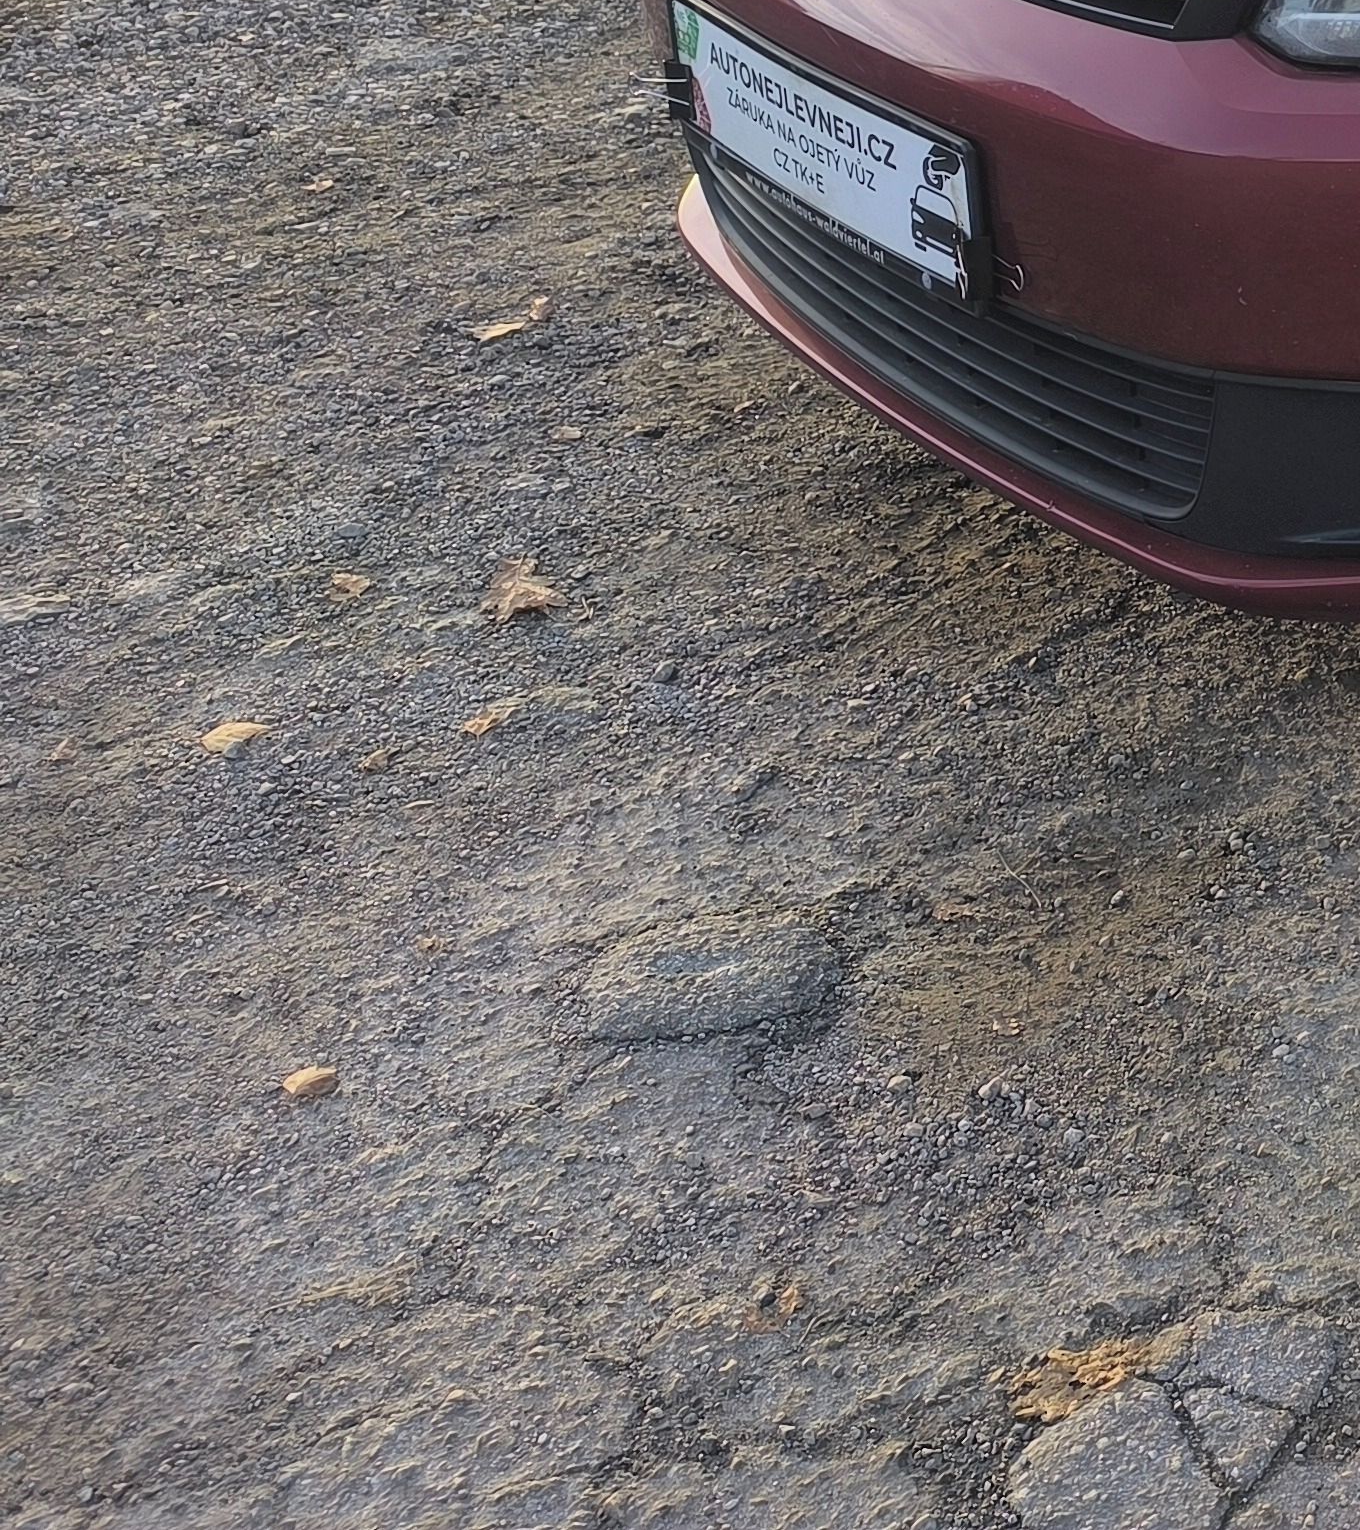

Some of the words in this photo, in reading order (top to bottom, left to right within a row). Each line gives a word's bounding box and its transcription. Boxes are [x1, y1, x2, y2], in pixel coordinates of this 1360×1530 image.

[710, 42, 897, 171] AUTONEJLEVNEJI.CZ
[726, 86, 776, 135] ZÁRUKA
[777, 122, 797, 149] NA
[799, 133, 841, 172] OJETÝ
[843, 157, 877, 192] VŮZ
[773, 147, 791, 173] CZ
[791, 157, 825, 194] TK+E
